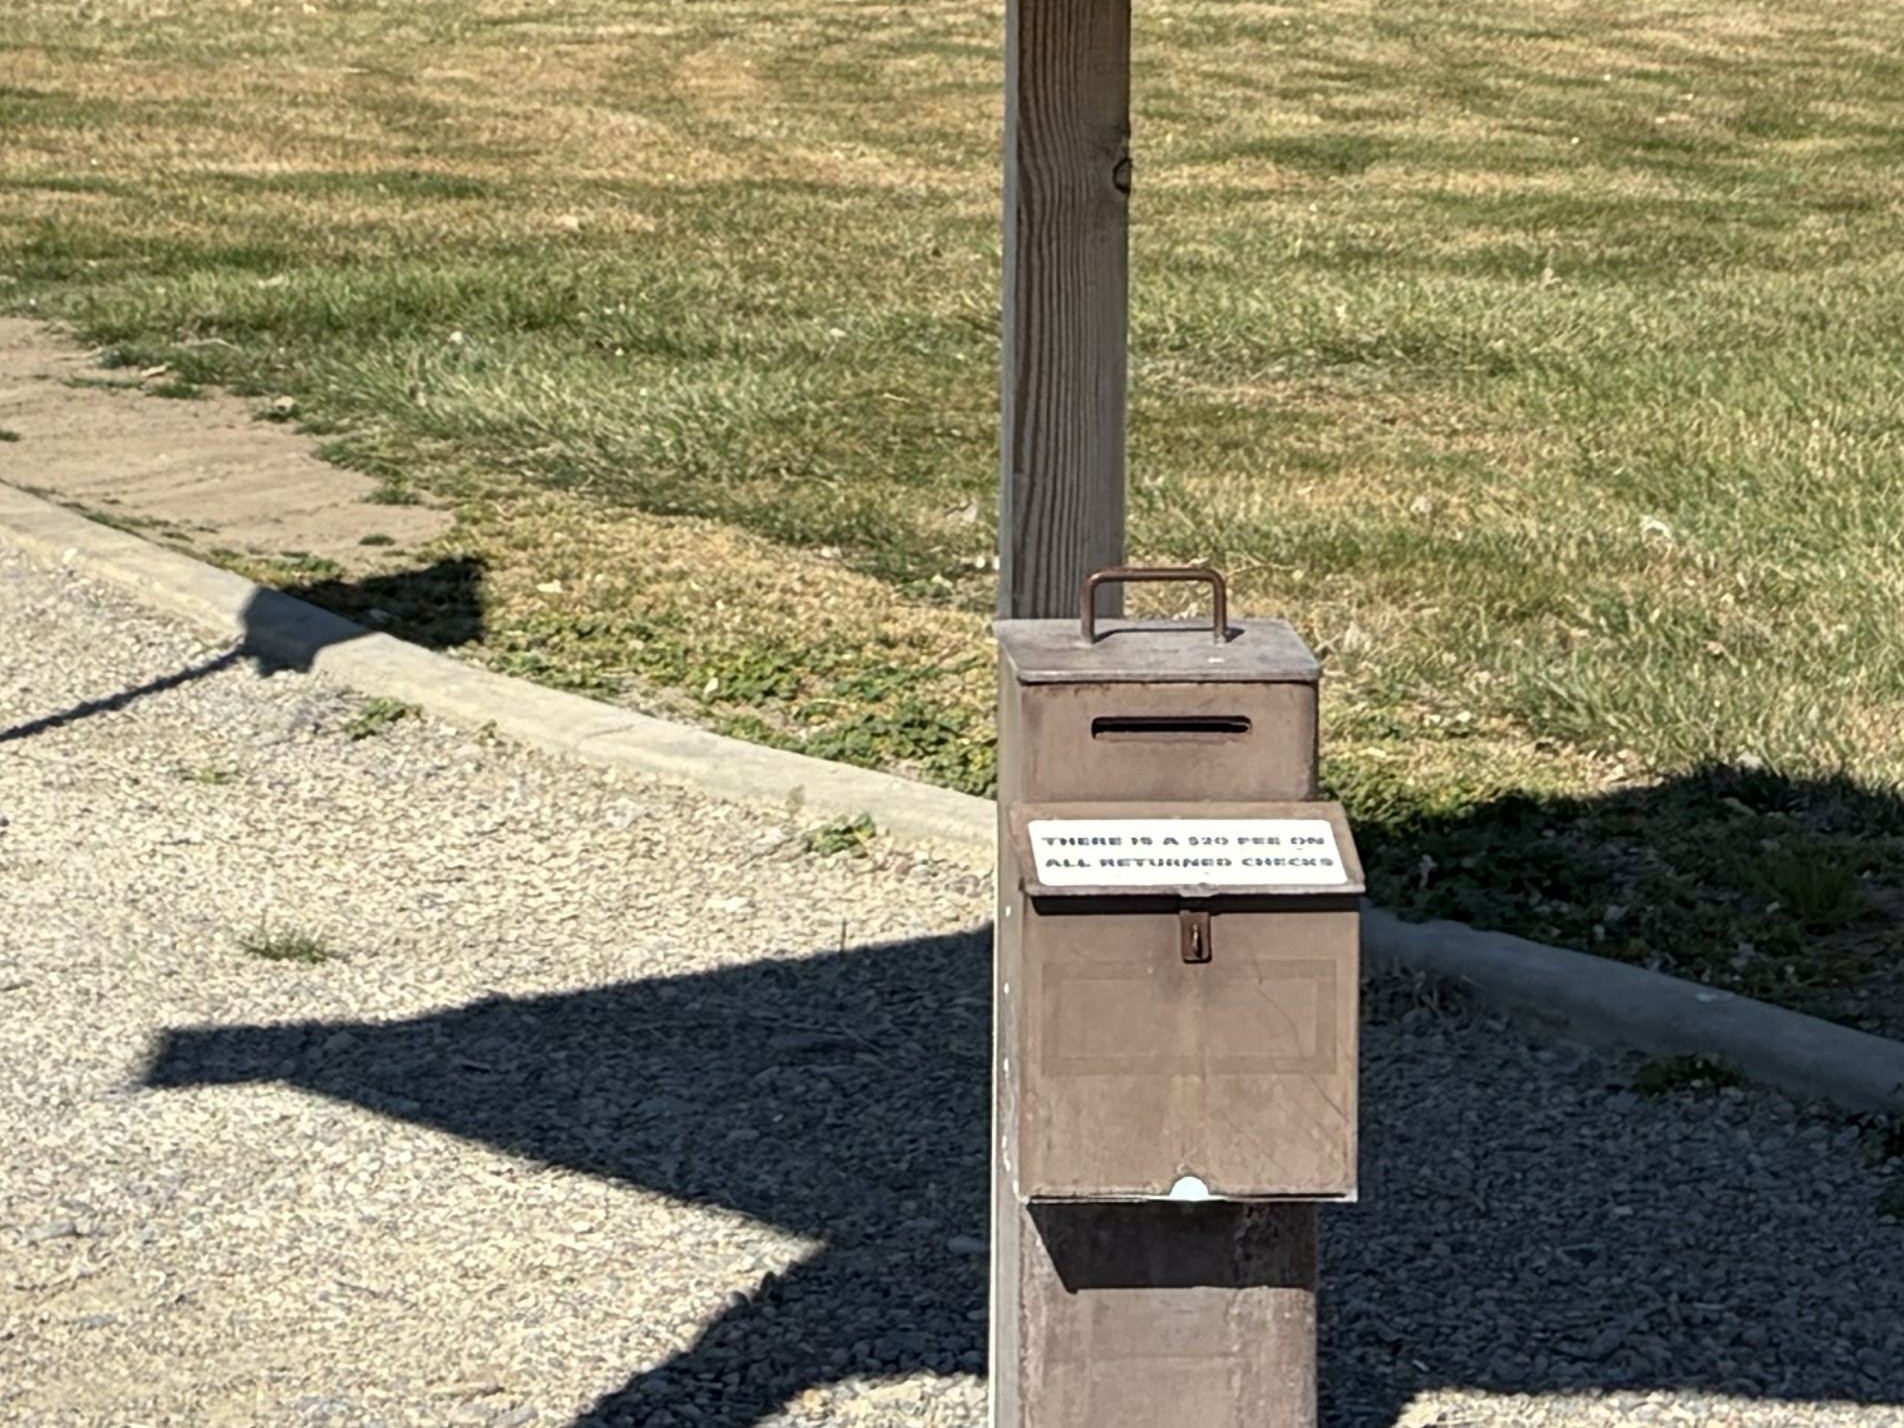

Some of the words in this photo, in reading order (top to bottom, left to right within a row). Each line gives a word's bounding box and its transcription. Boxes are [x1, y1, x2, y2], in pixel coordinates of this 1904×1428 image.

[1041, 836, 1121, 846] THERE
[1130, 836, 1153, 846] IS
[1162, 836, 1179, 846] A
[1188, 836, 1229, 846] $20
[1237, 836, 1280, 845] FEE
[1290, 836, 1324, 845] ON
[1045, 858, 1091, 868] ALL
[1099, 857, 1232, 868] RETURNED
[1241, 857, 1333, 867] CHECKS
